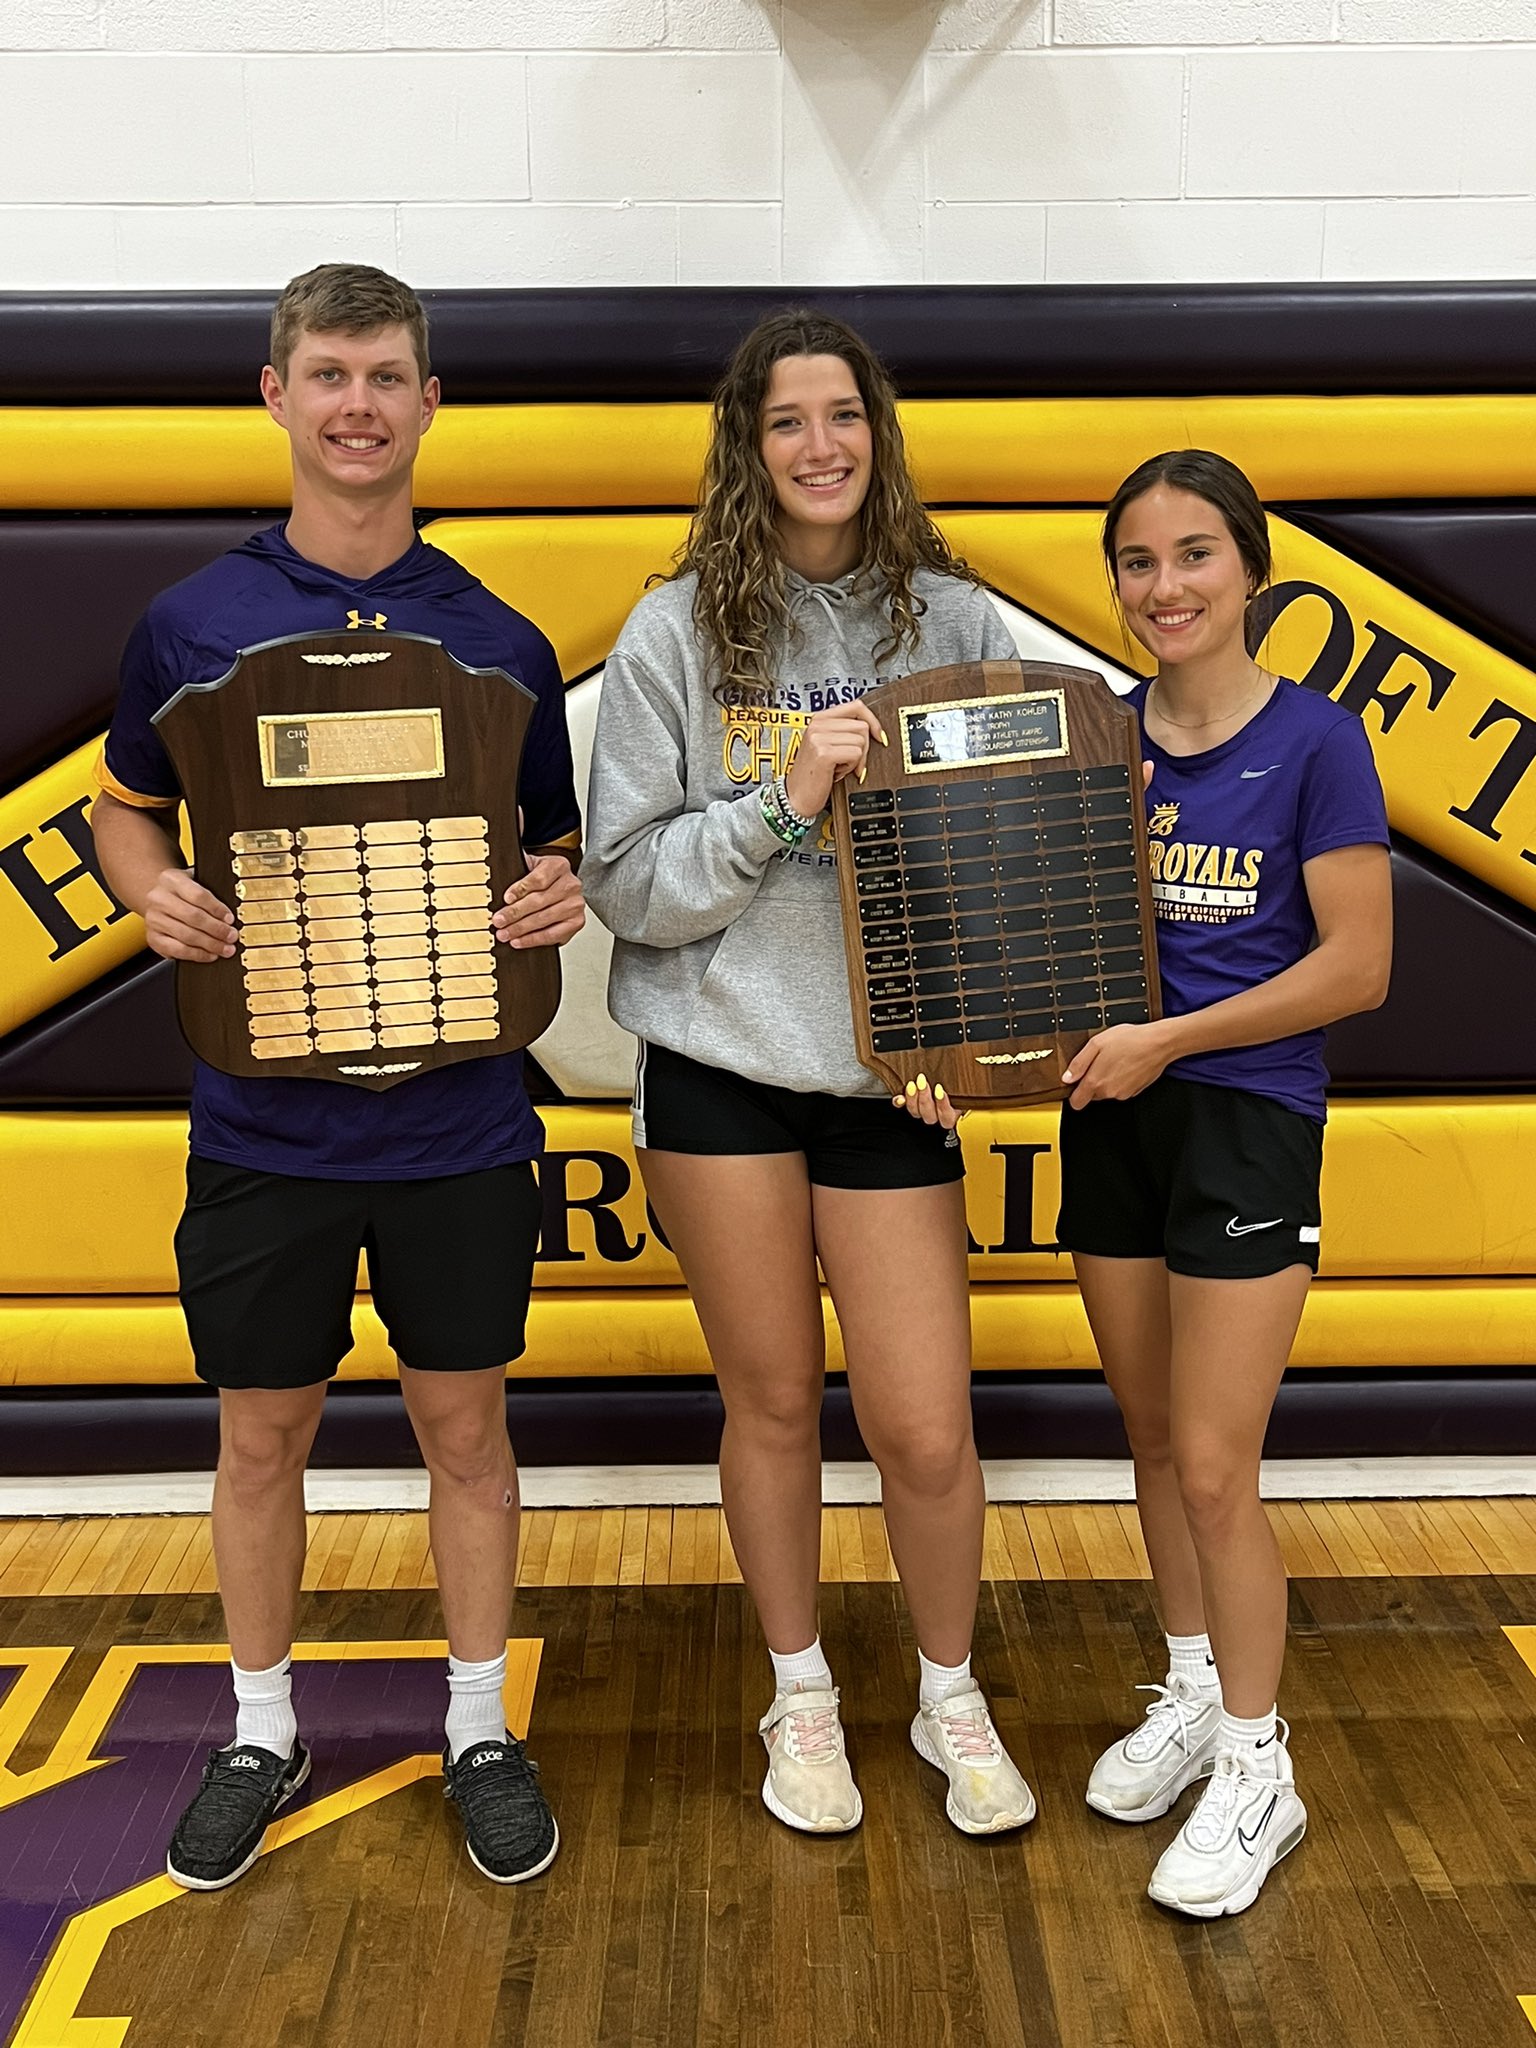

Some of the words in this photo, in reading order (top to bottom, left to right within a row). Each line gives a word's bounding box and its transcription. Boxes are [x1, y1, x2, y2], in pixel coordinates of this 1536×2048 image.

[1244, 580, 1457, 735] OF
[727, 709, 790, 724] LEAGUE
[989, 710, 1014, 720] KATHY
[1017, 706, 1047, 717] KOHLER
[1149, 840, 1264, 888] ROYALS
[1174, 903, 1256, 917] SPECIFICATIONS
[1164, 911, 1188, 921] LADY
[1189, 913, 1228, 924] ROYALS
